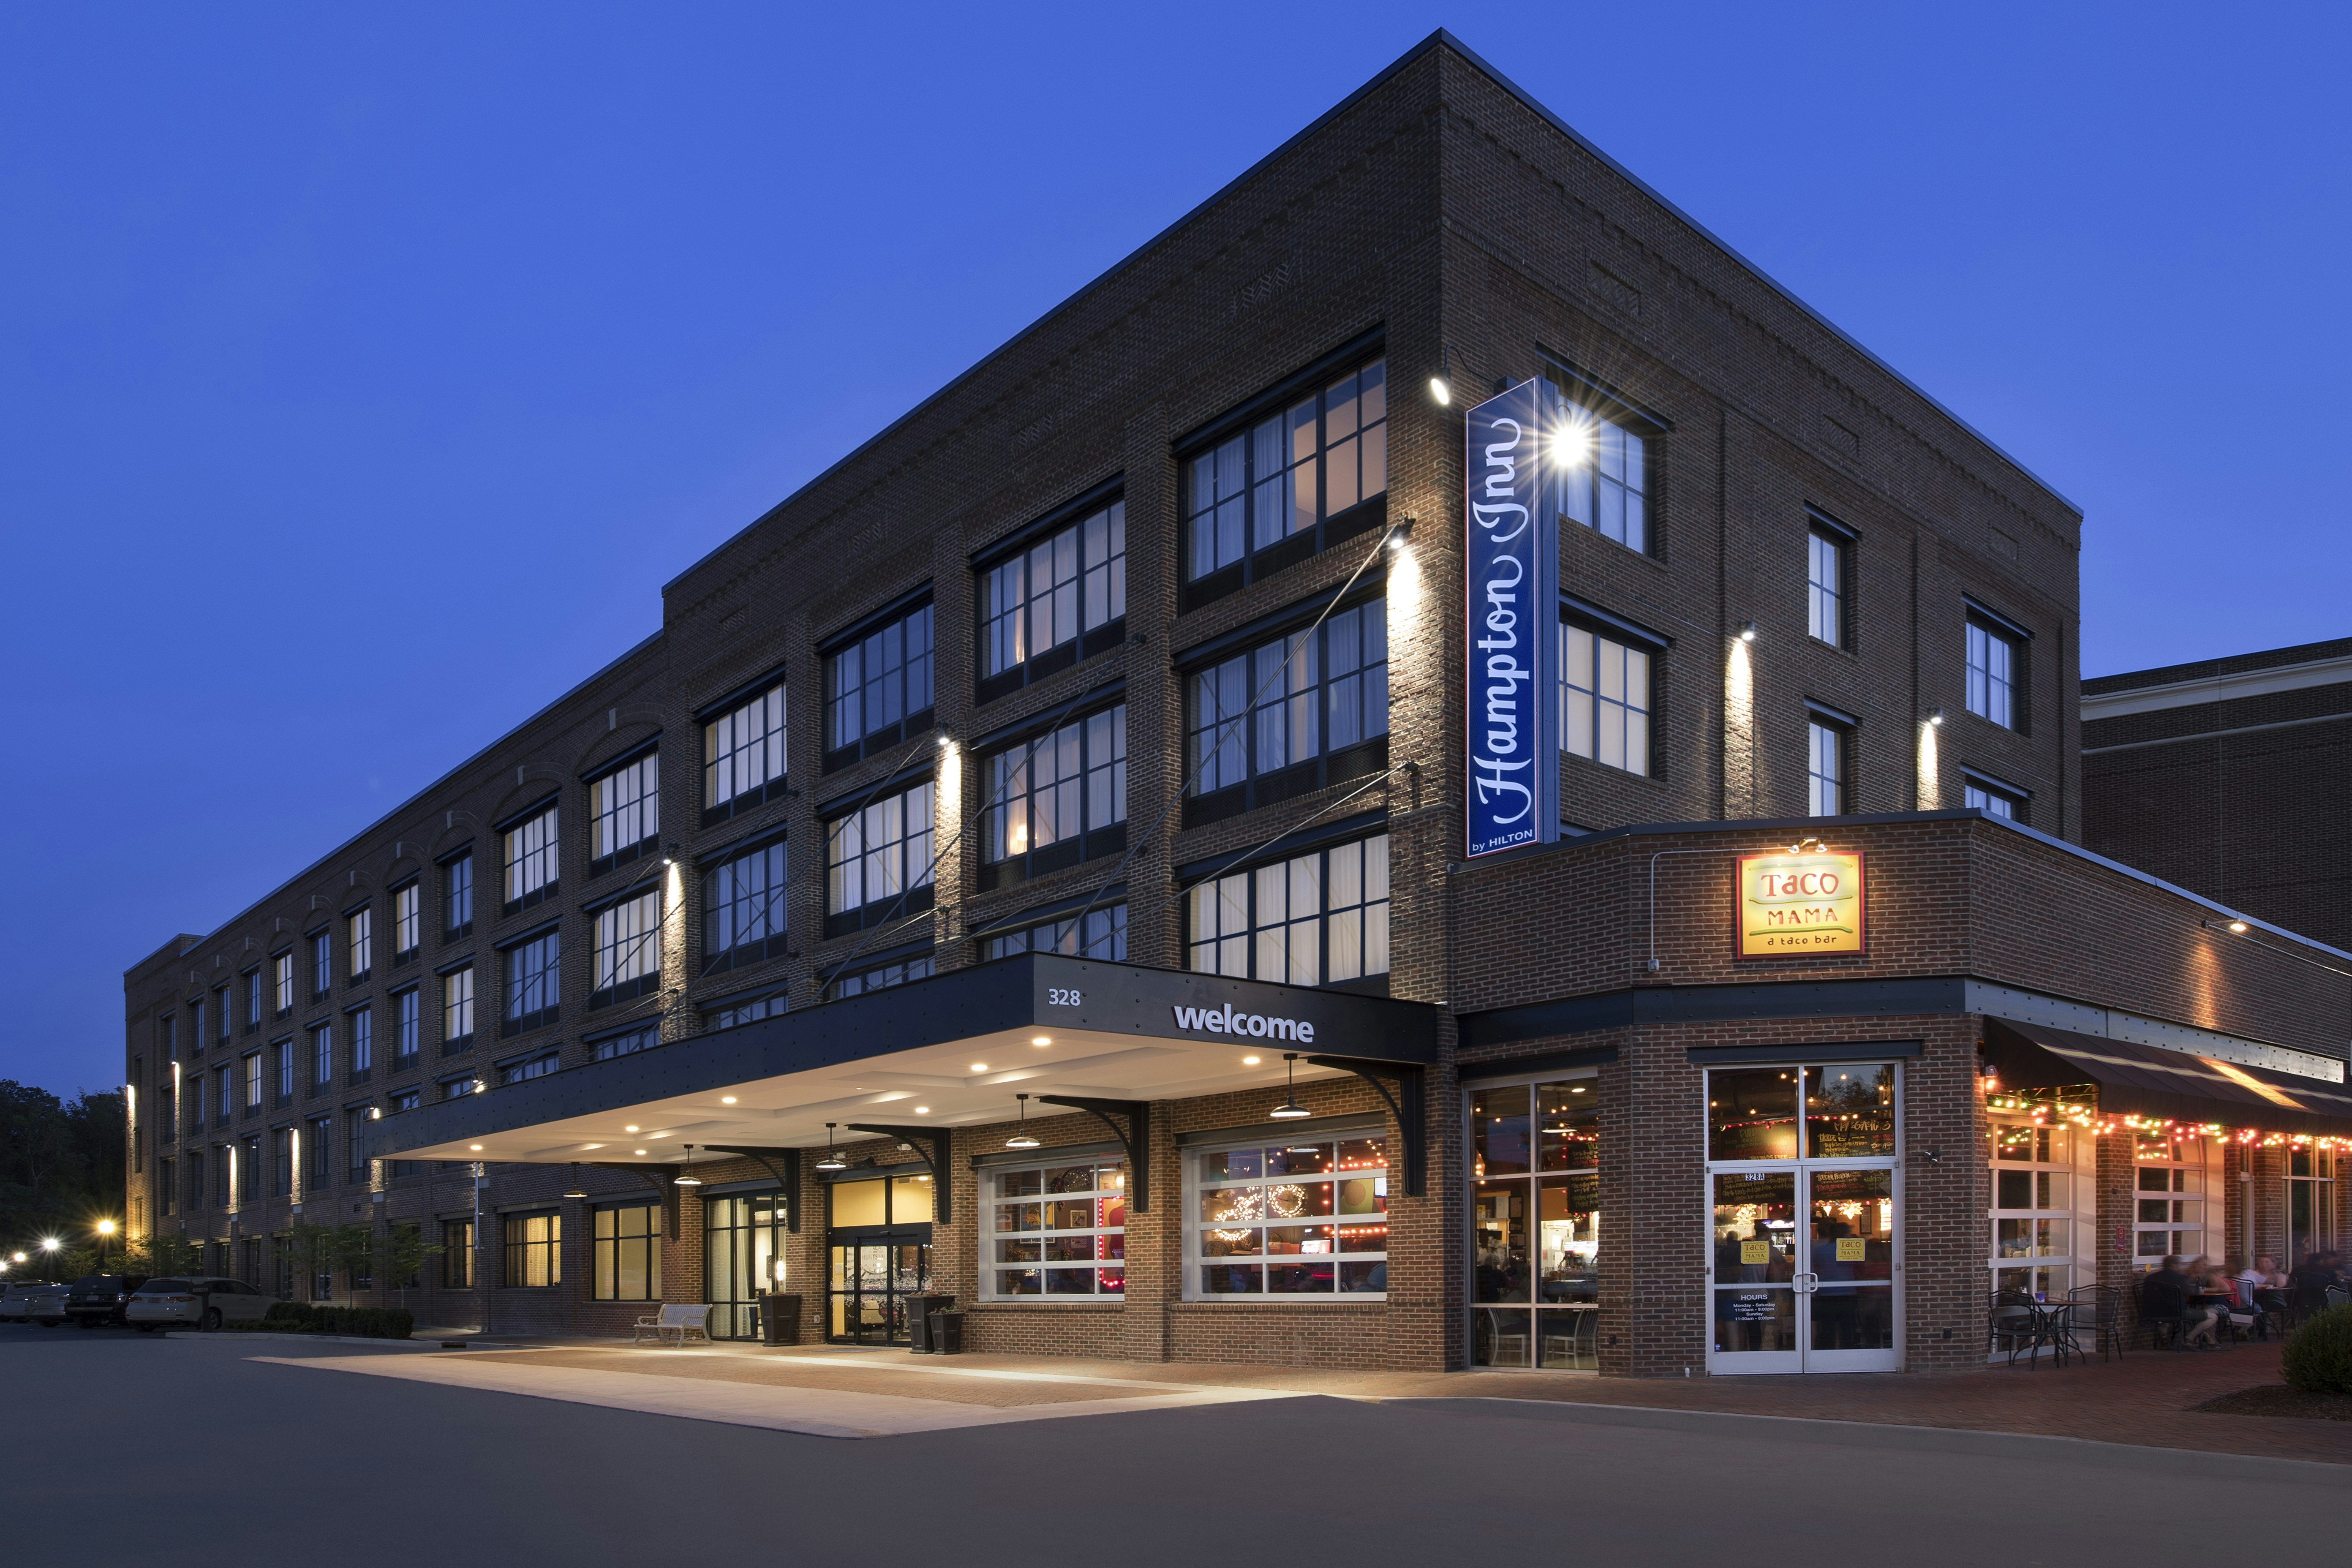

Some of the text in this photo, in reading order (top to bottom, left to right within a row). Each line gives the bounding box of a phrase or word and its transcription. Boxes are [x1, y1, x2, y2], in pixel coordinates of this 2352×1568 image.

[1473, 418, 1533, 824] Hampton Inn
[1473, 829, 1533, 852] by HILTON
[1768, 908, 1838, 926] MAMA
[1780, 936, 1808, 945] taco
[1815, 935, 1837, 944] bar
[1048, 988, 1081, 1006] 328
[1172, 1003, 1314, 1043] welcome
